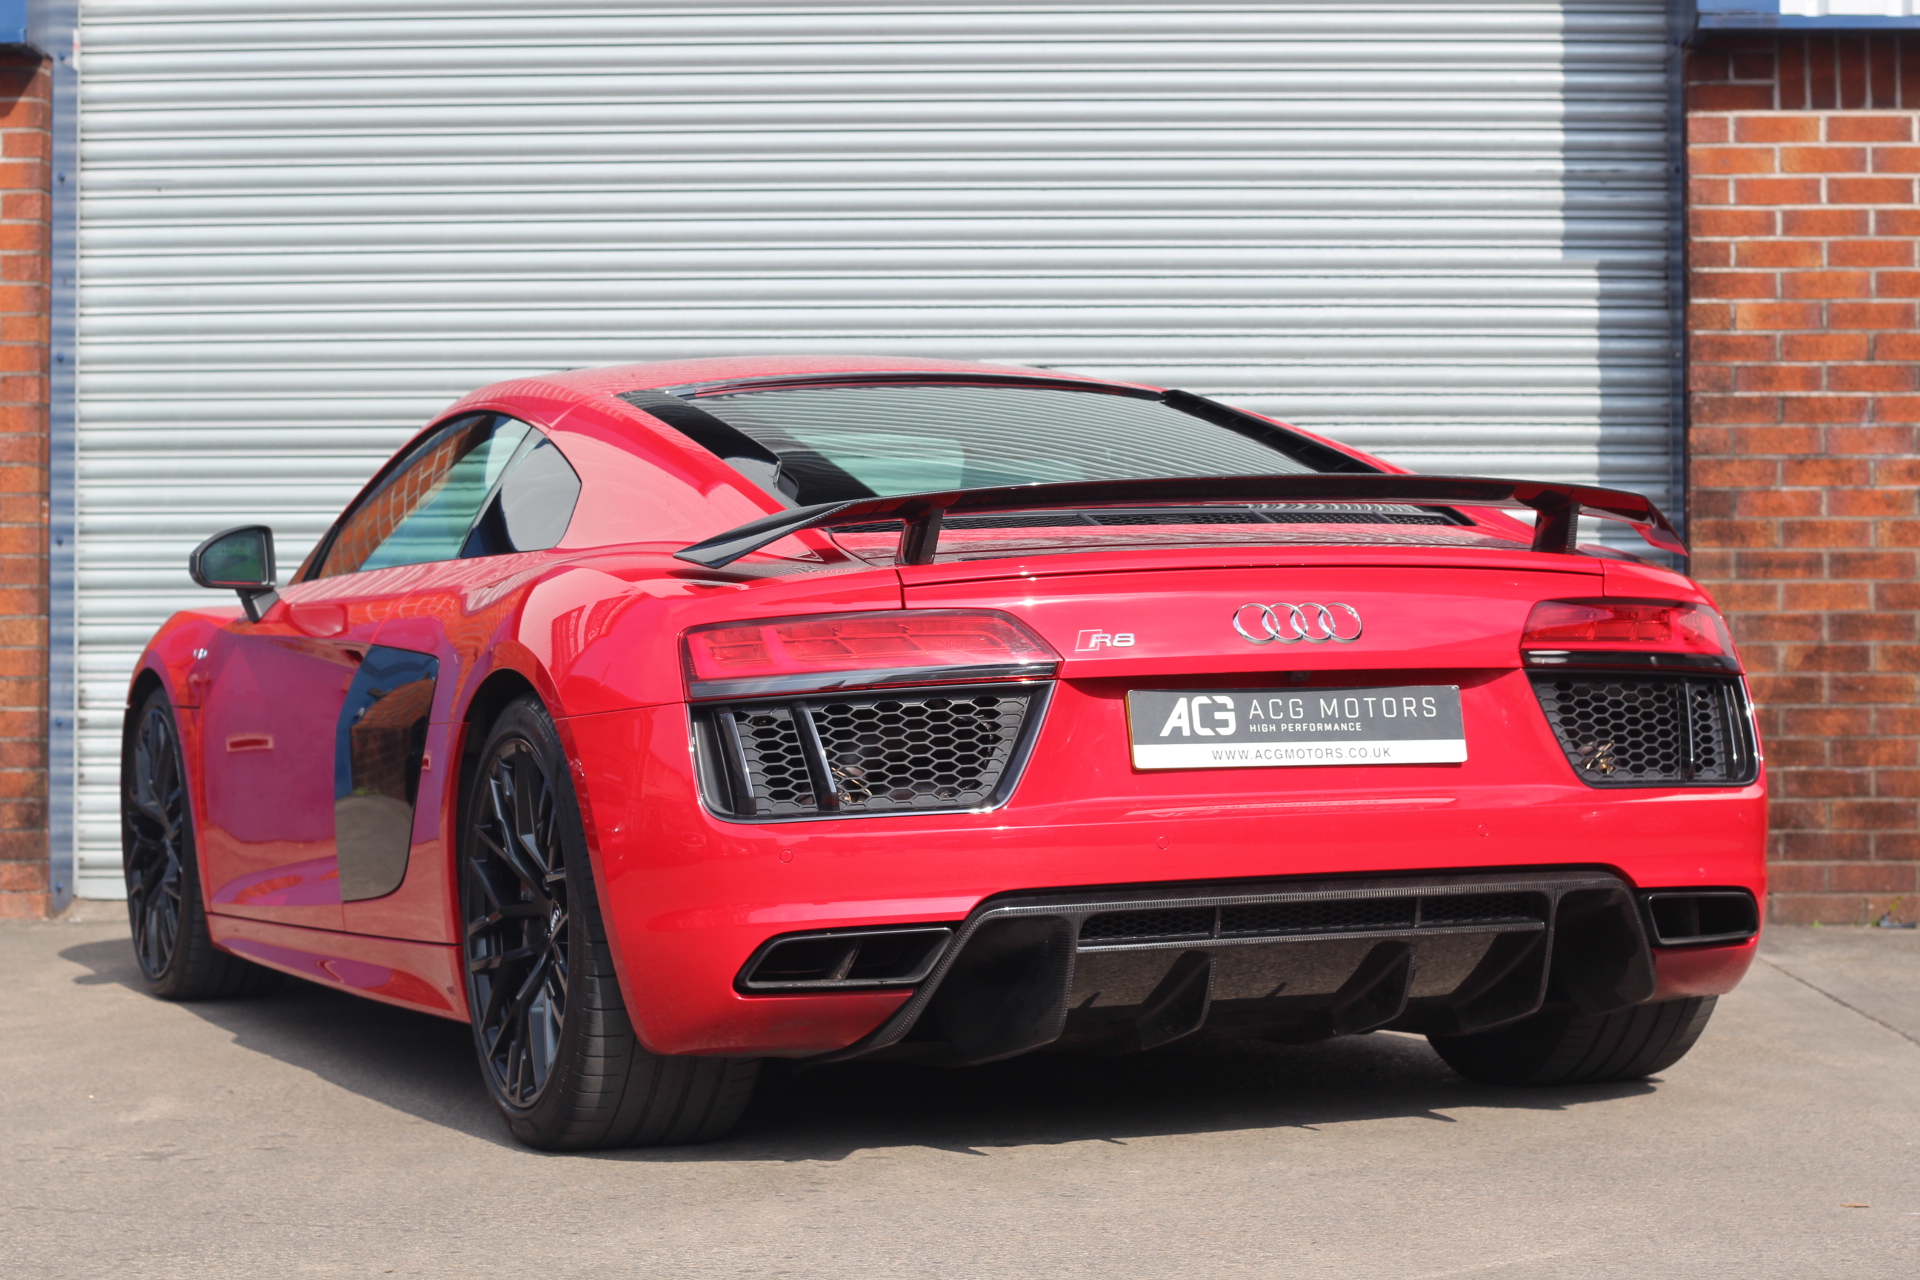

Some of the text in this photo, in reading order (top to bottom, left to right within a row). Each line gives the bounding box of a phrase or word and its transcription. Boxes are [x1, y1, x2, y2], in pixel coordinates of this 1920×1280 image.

[1088, 632, 1135, 649] R8
[1159, 695, 1237, 737] ACG
[1248, 696, 1437, 720] ACG MOTORS
[1249, 722, 1362, 733] HIGH PERFORMANCE
[1211, 747, 1392, 761] WWW.ACGMOTORS.CO.UK
